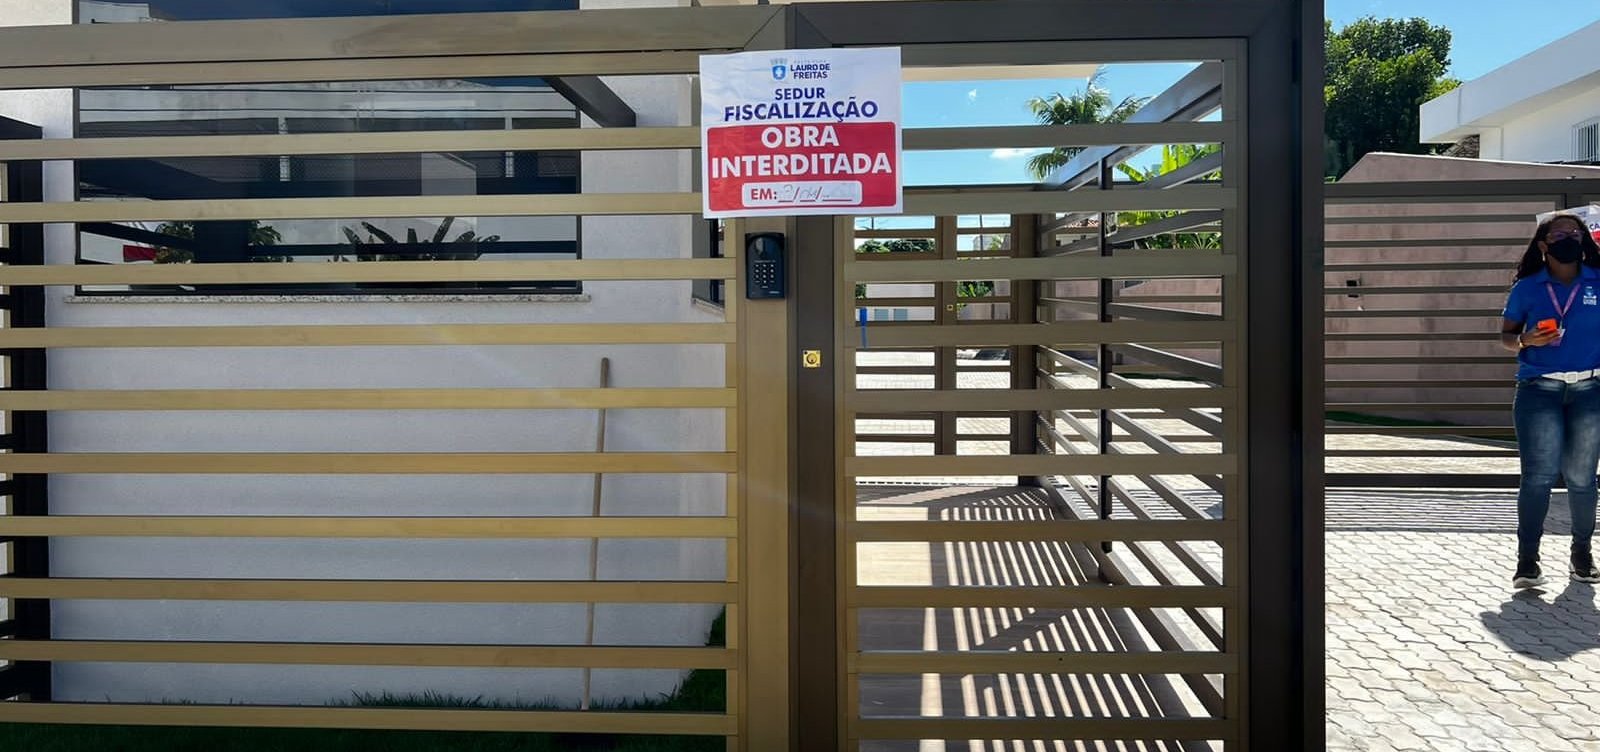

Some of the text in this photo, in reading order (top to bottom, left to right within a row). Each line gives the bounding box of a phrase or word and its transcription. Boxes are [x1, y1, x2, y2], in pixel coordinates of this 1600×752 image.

[790, 63, 831, 72] LAURO DE
[793, 71, 828, 80] FREITAS
[774, 87, 826, 100] SEDUR
[724, 96, 878, 122] FISCALIZAÇÃO
[761, 125, 840, 149] OBRA
[712, 152, 892, 179] INTERDITADA
